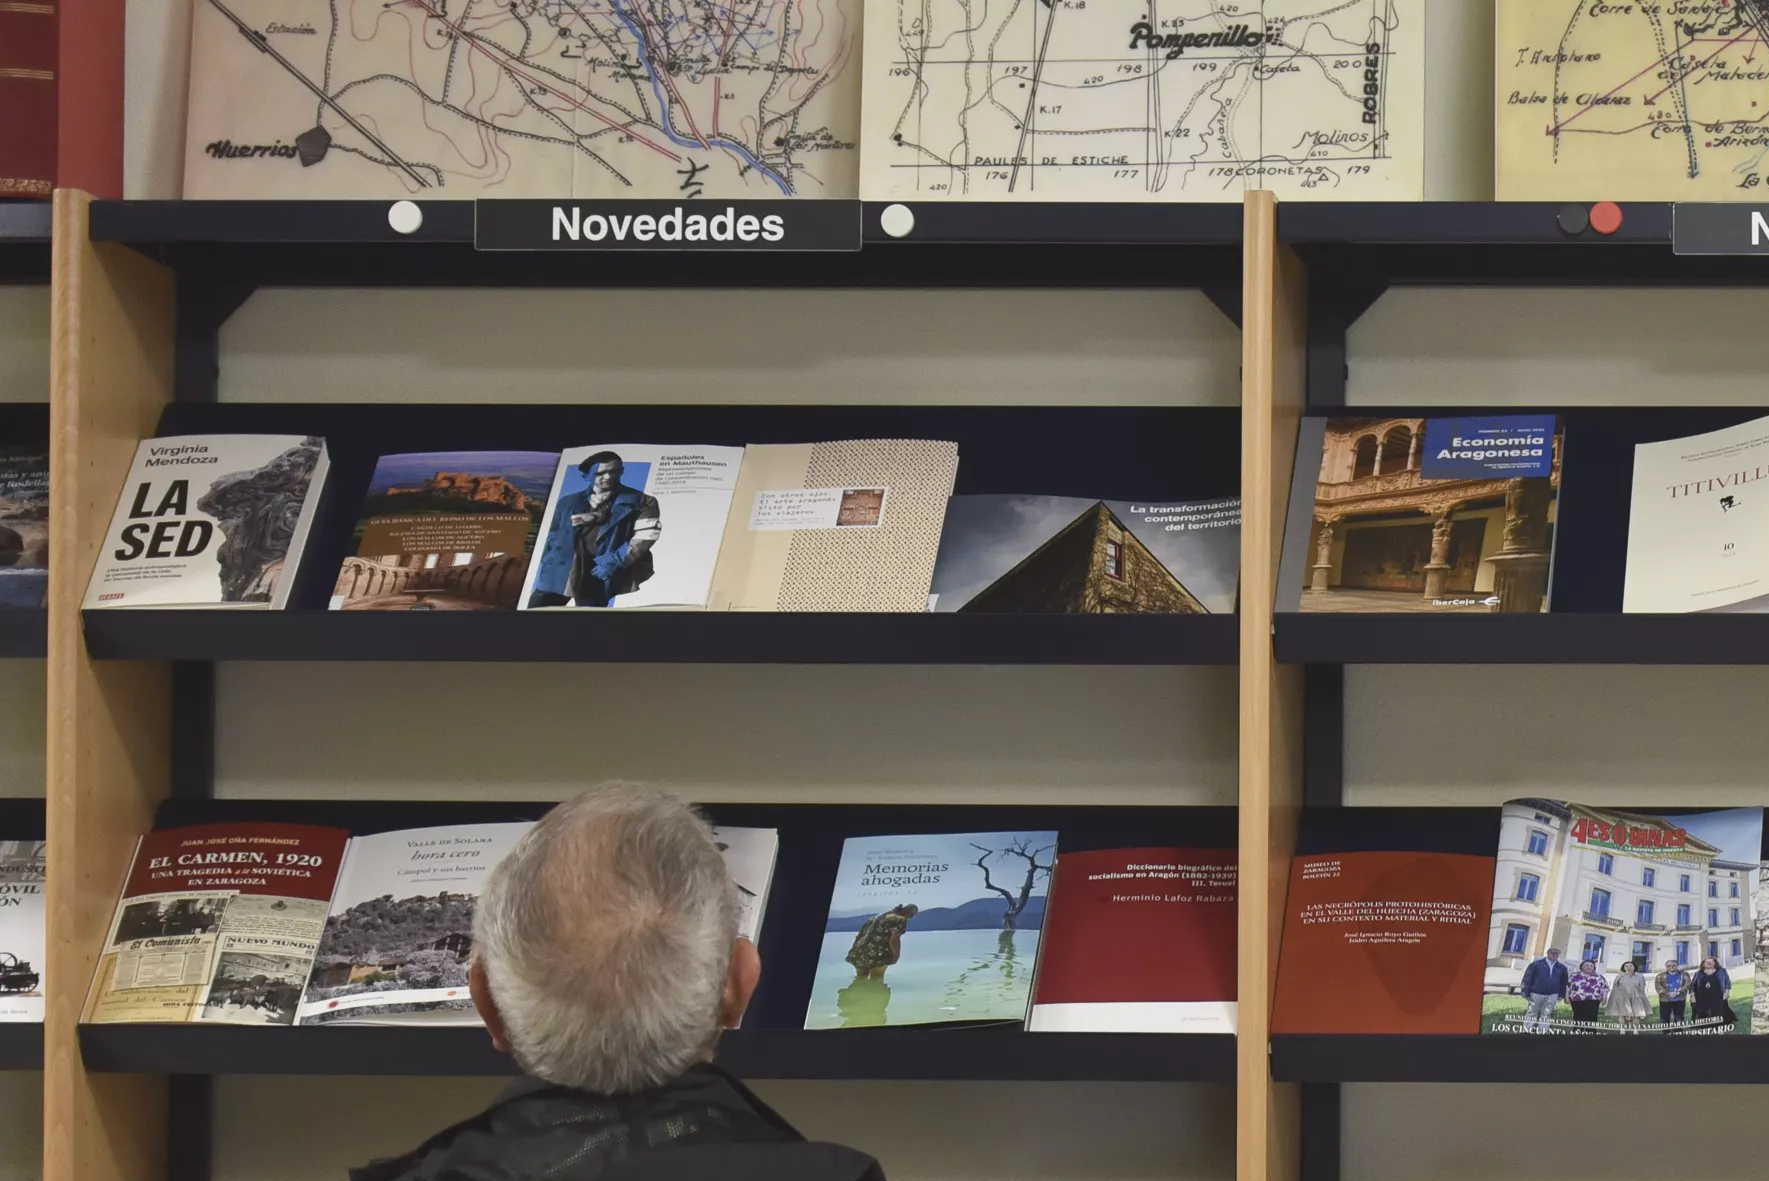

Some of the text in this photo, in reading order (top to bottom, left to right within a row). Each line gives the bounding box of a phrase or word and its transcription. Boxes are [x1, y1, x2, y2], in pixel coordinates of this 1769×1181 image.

[1116, 63, 1142, 74] 198
[1191, 62, 1218, 72] 199
[1362, 42, 1381, 124] ROBRES
[1292, 129, 1369, 150] Molinos
[1042, 155, 1129, 166] DE ESTICHE
[1113, 169, 1139, 179] 177
[1346, 165, 1371, 175] 179
[551, 207, 784, 241] Novedades
[1452, 435, 1544, 447] Economía
[149, 444, 209, 457] Virginia
[1436, 449, 1543, 461] Aragonesa
[144, 455, 219, 468] Mendoza
[128, 479, 190, 519] LA
[1130, 505, 1146, 513] La
[1164, 518, 1242, 532] del territorio
[114, 520, 213, 561] SED
[148, 852, 323, 869] EL CARMEN, 1920
[151, 867, 312, 879] UNA TRAGEDIA SOVIÉTICA
[863, 861, 949, 874] Memorias
[1177, 864, 1222, 872] biográfico
[861, 873, 941, 887] ahogadas
[1088, 872, 1134, 880] socialismo
[1148, 871, 1179, 879] Aragón
[187, 878, 267, 886] EN ZARAGOZA
[1112, 894, 1193, 902] Herminio Lafoz
[1324, 901, 1384, 909] NECRÓPOLIS
[1385, 901, 1472, 911] PROTOHISTÓRICAS
